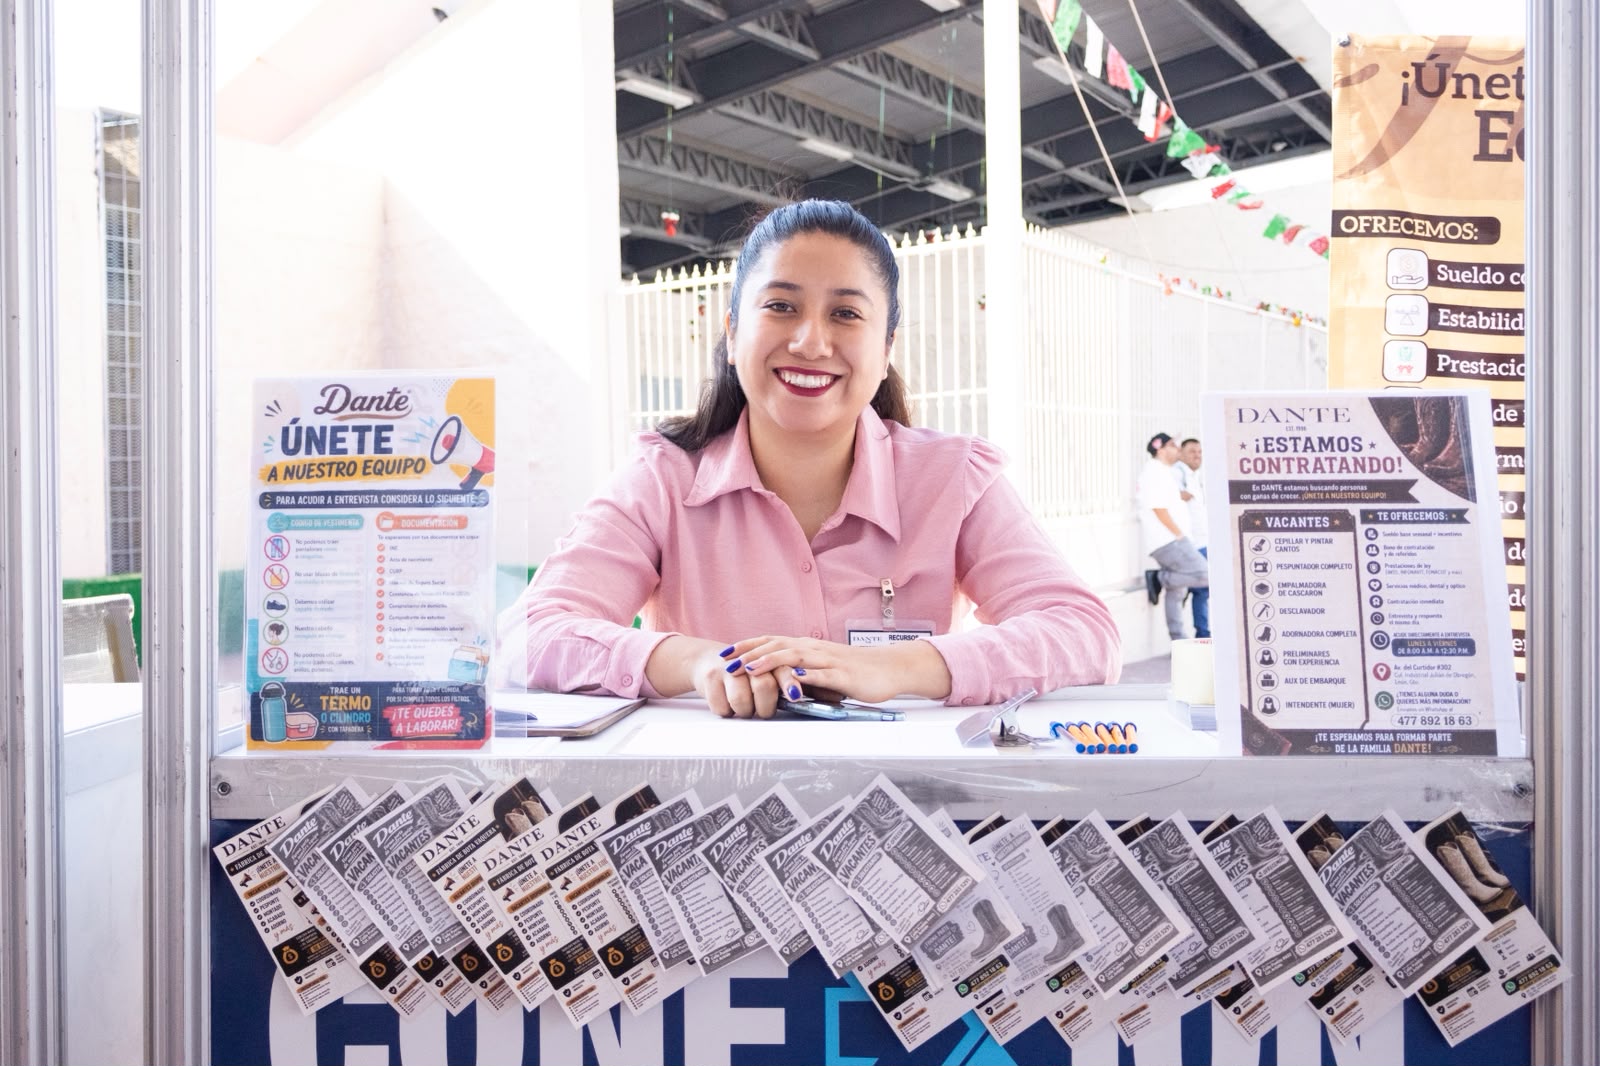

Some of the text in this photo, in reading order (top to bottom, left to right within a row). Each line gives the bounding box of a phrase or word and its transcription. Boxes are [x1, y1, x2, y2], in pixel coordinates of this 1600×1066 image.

[1340, 215, 1479, 240] OFRECEMOS:
[1437, 264, 1505, 284] Sueldo
[313, 383, 413, 415] Dante
[1238, 407, 1351, 423] DANTE
[1493, 404, 1518, 422] de
[281, 417, 394, 456] ÚNETE
[1254, 436, 1363, 454] ¡ESTAMOS
[267, 458, 426, 482] A NUESTRO EQUIPO
[1239, 456, 1403, 475] CONTRATANDO!
[276, 496, 295, 505] PARA
[298, 495, 325, 504] ACUDIR
[327, 495, 333, 504] A
[334, 494, 378, 504] ENTREVISTA
[381, 494, 423, 504] CONSIDERA
[425, 494, 434, 503] LO
[1265, 516, 1330, 528] VACANTES
[1377, 511, 1449, 521] TE OFRECEMOS:
[1277, 582, 1327, 590] EMPALMADORA
[1282, 630, 1324, 638] ADORNADORA
[1283, 650, 1330, 658] PRELIMINARES
[1309, 677, 1346, 685] EMBARQUE
[320, 696, 371, 711] TERMO
[392, 706, 454, 721] ¡TE QUEDES
[1285, 700, 1355, 710] INTENDENTE (MUJER)
[321, 712, 370, 723] O CILINDRO
[396, 719, 459, 734] A LABORAR!
[1398, 716, 1472, 725] 477 892 18 63
[1315, 733, 1452, 743] ¡TE ESPERAMOS PARA FORMAR PARTE
[1335, 744, 1432, 753] DE LA FAMILIA DANTE!
[222, 816, 286, 857] DANTE
[280, 817, 318, 858] Dante
[373, 810, 413, 848] Dante
[421, 814, 480, 863] DANTE
[541, 817, 601, 861] DANTE
[610, 821, 652, 855] Dante
[388, 829, 430, 869] VACANTES
[652, 827, 694, 860] Dante
[710, 823, 748, 863] Dante
[820, 818, 855, 861] Dante
[483, 828, 544, 872] DANTE
[772, 832, 813, 870] Dante
[840, 835, 876, 879] VACANTES
[1321, 846, 1355, 885] Dante
[1335, 864, 1375, 906] VACANTES
[934, 935, 956, 955] DANTE!
[1518, 976, 1528, 985] 477
